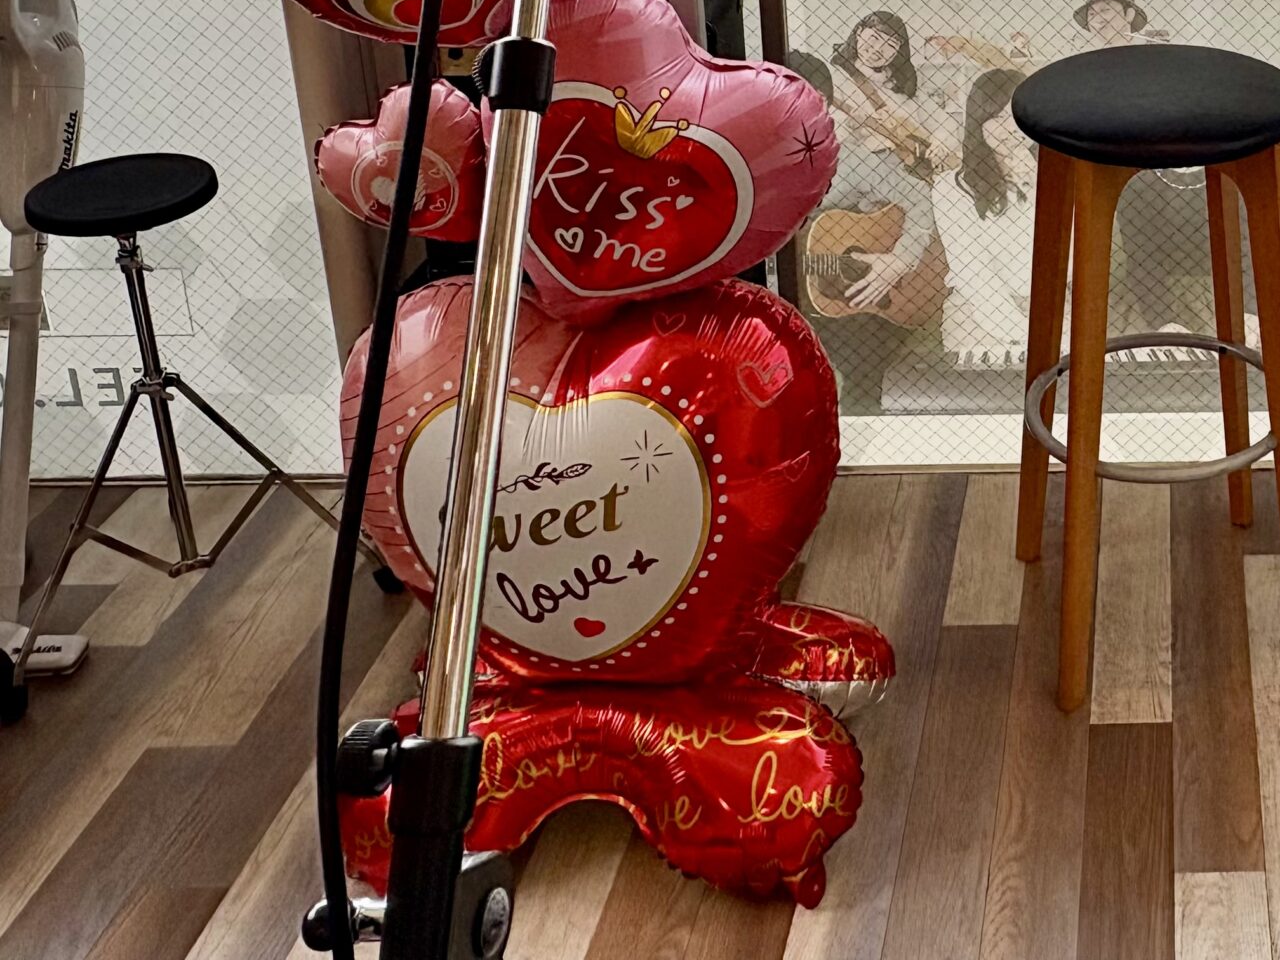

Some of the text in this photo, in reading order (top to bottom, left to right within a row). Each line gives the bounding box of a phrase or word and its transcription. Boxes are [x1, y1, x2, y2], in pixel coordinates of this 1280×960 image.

[593, 228, 667, 273] me
[439, 482, 630, 552] weet
[496, 553, 629, 624] love
[737, 750, 852, 824] love
